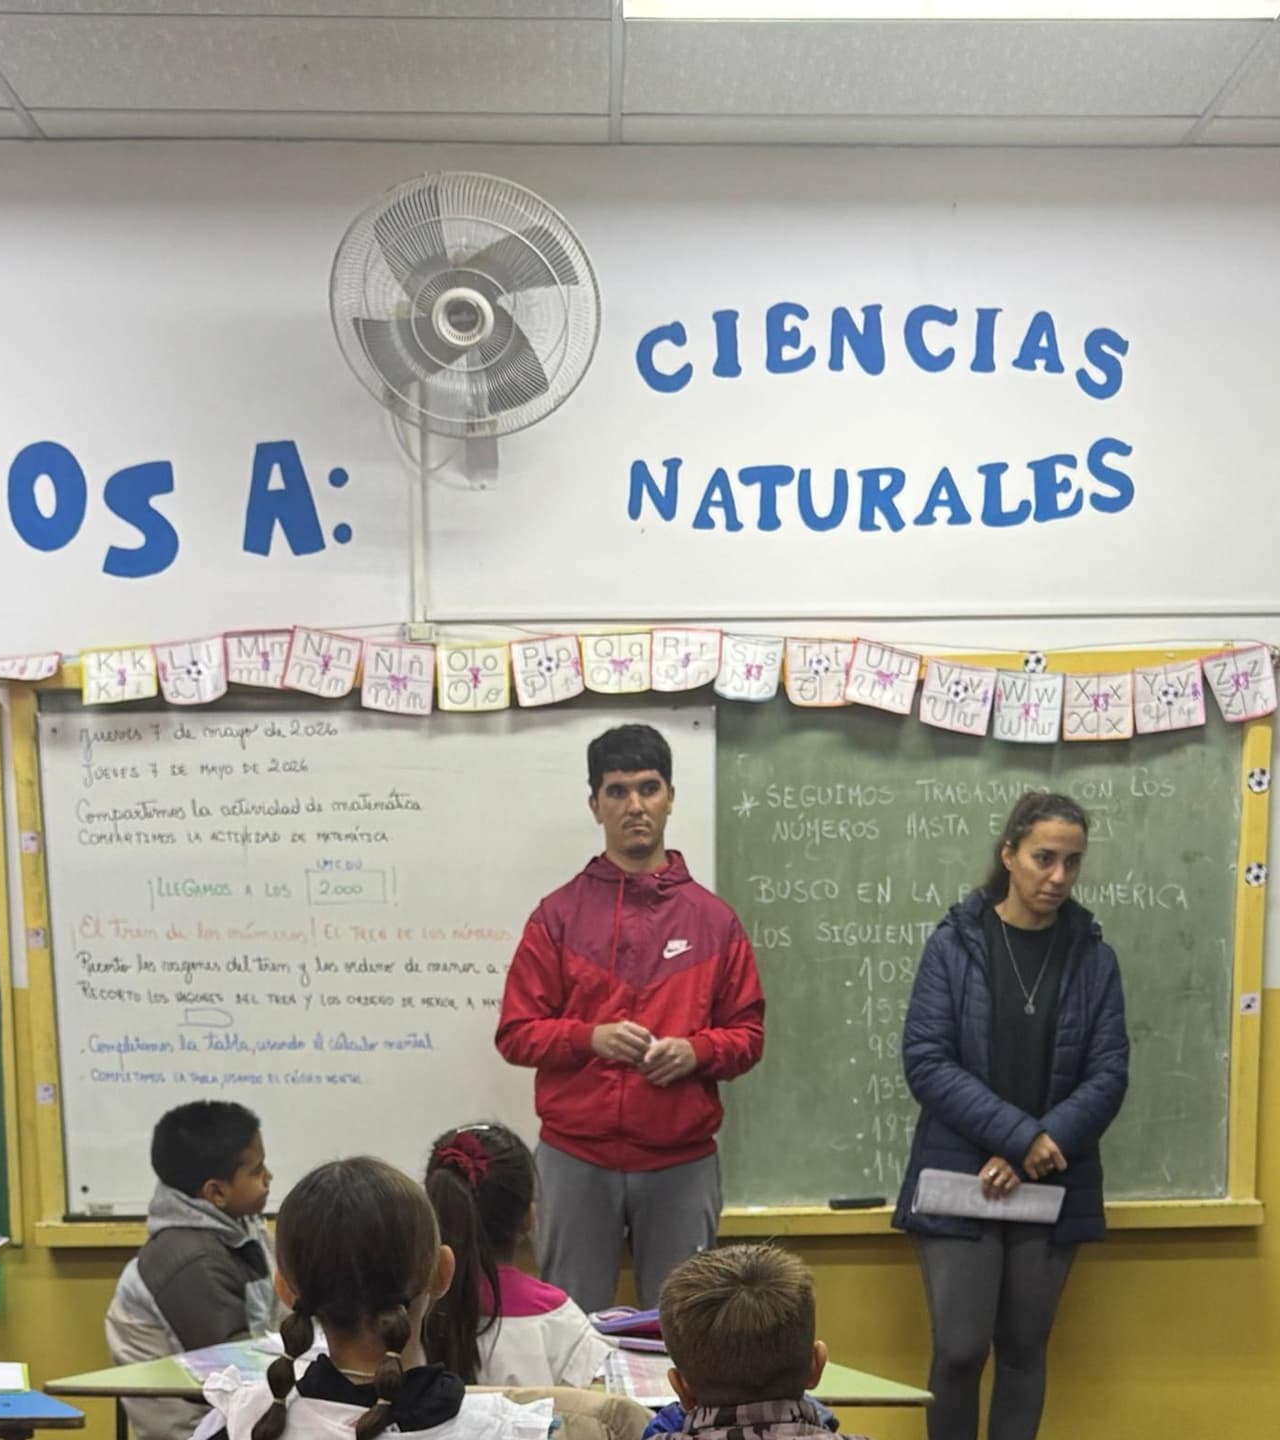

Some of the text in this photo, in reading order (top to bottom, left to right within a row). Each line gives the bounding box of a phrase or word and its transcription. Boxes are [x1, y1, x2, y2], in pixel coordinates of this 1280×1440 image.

[636, 302, 1130, 400] CIENCIAS
[243, 440, 353, 557] A:
[628, 437, 1135, 532] NATURALES
[150, 725, 161, 740] 7
[174, 724, 196, 740] de
[203, 723, 258, 749] mayo
[264, 723, 287, 740] de
[82, 765, 141, 788] JUEVES
[199, 763, 233, 780] MAYO
[268, 757, 308, 773] 2026
[192, 798, 213, 817] la
[306, 796, 324, 814] de
[766, 783, 895, 808] SEGUIMOS
[1071, 776, 1113, 800] CON
[1130, 774, 1176, 797] LOS
[772, 812, 880, 845] NÚMEROS
[906, 812, 969, 840] HASTA
[265, 882, 291, 897] LOS
[748, 876, 839, 904] BUSCO
[856, 876, 892, 904] EN
[911, 880, 941, 906] LA
[1071, 870, 1188, 910] NUMÉRICA
[751, 920, 792, 949] LOS
